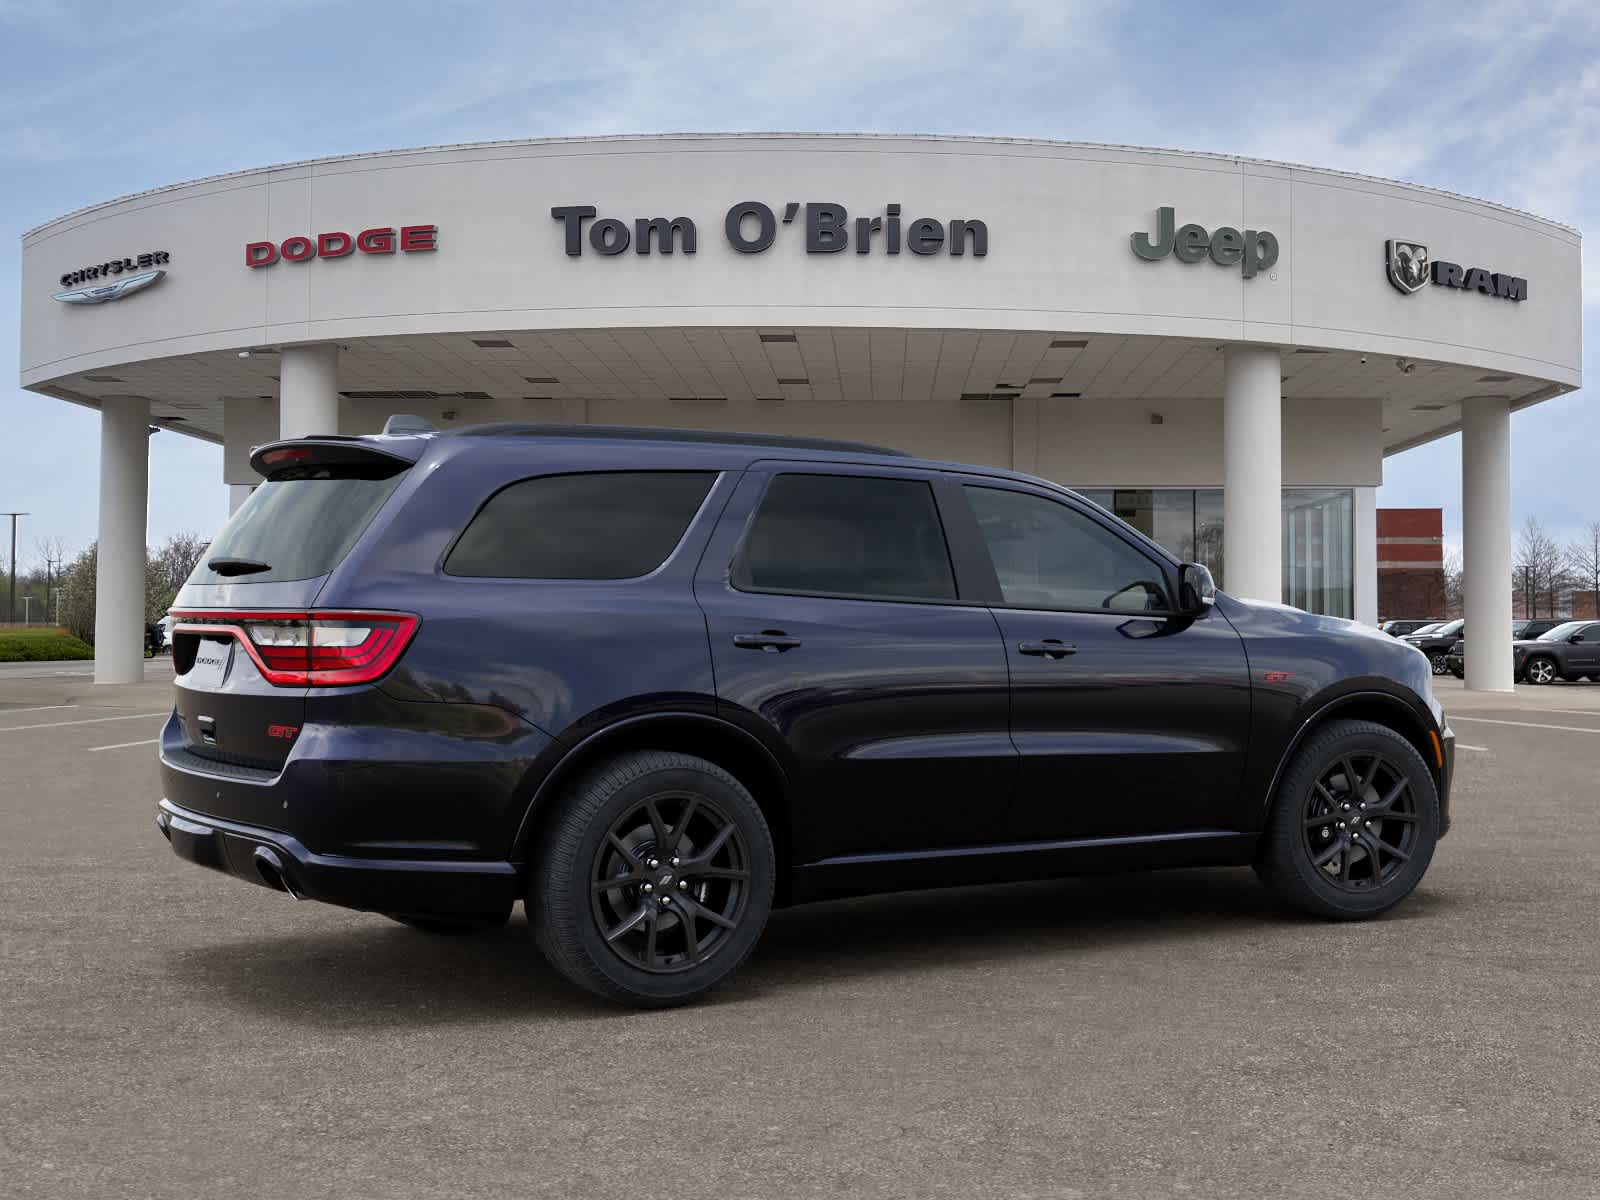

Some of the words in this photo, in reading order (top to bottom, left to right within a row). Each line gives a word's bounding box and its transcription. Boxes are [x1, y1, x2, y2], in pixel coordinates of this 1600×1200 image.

[245, 224, 438, 269] DODGE
[551, 205, 697, 257] Tom
[725, 201, 989, 257] O'Brien
[1130, 206, 1279, 279] Jeep
[60, 250, 170, 286] CHRYSLER
[1431, 260, 1528, 302] RAM
[267, 724, 298, 739] GT
